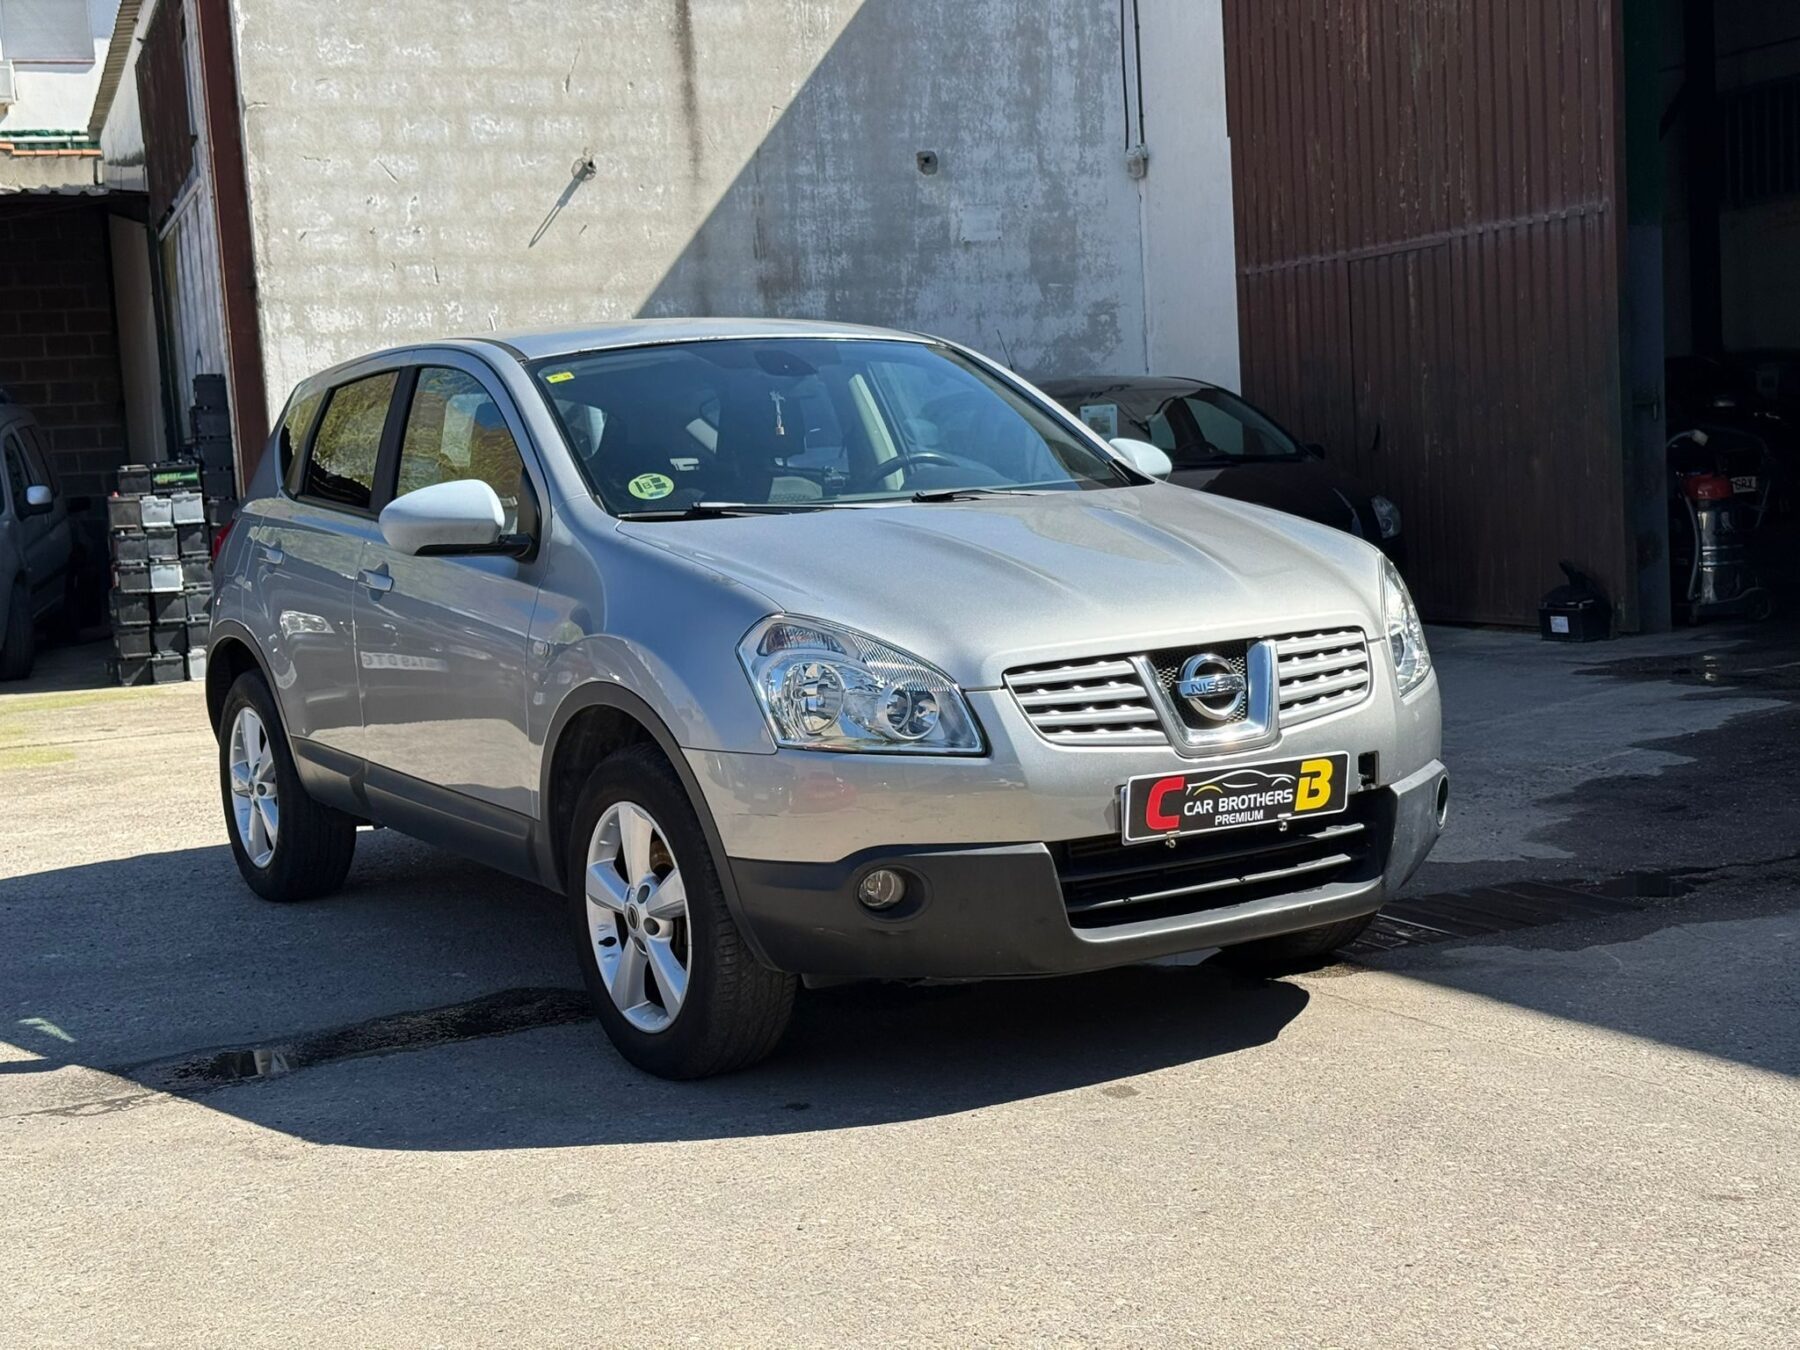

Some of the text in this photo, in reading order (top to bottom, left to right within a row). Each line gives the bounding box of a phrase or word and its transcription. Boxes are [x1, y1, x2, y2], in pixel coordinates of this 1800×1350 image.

[1184, 788, 1294, 816] CAR BROTHERS
[1214, 809, 1265, 827] PREMIUM
